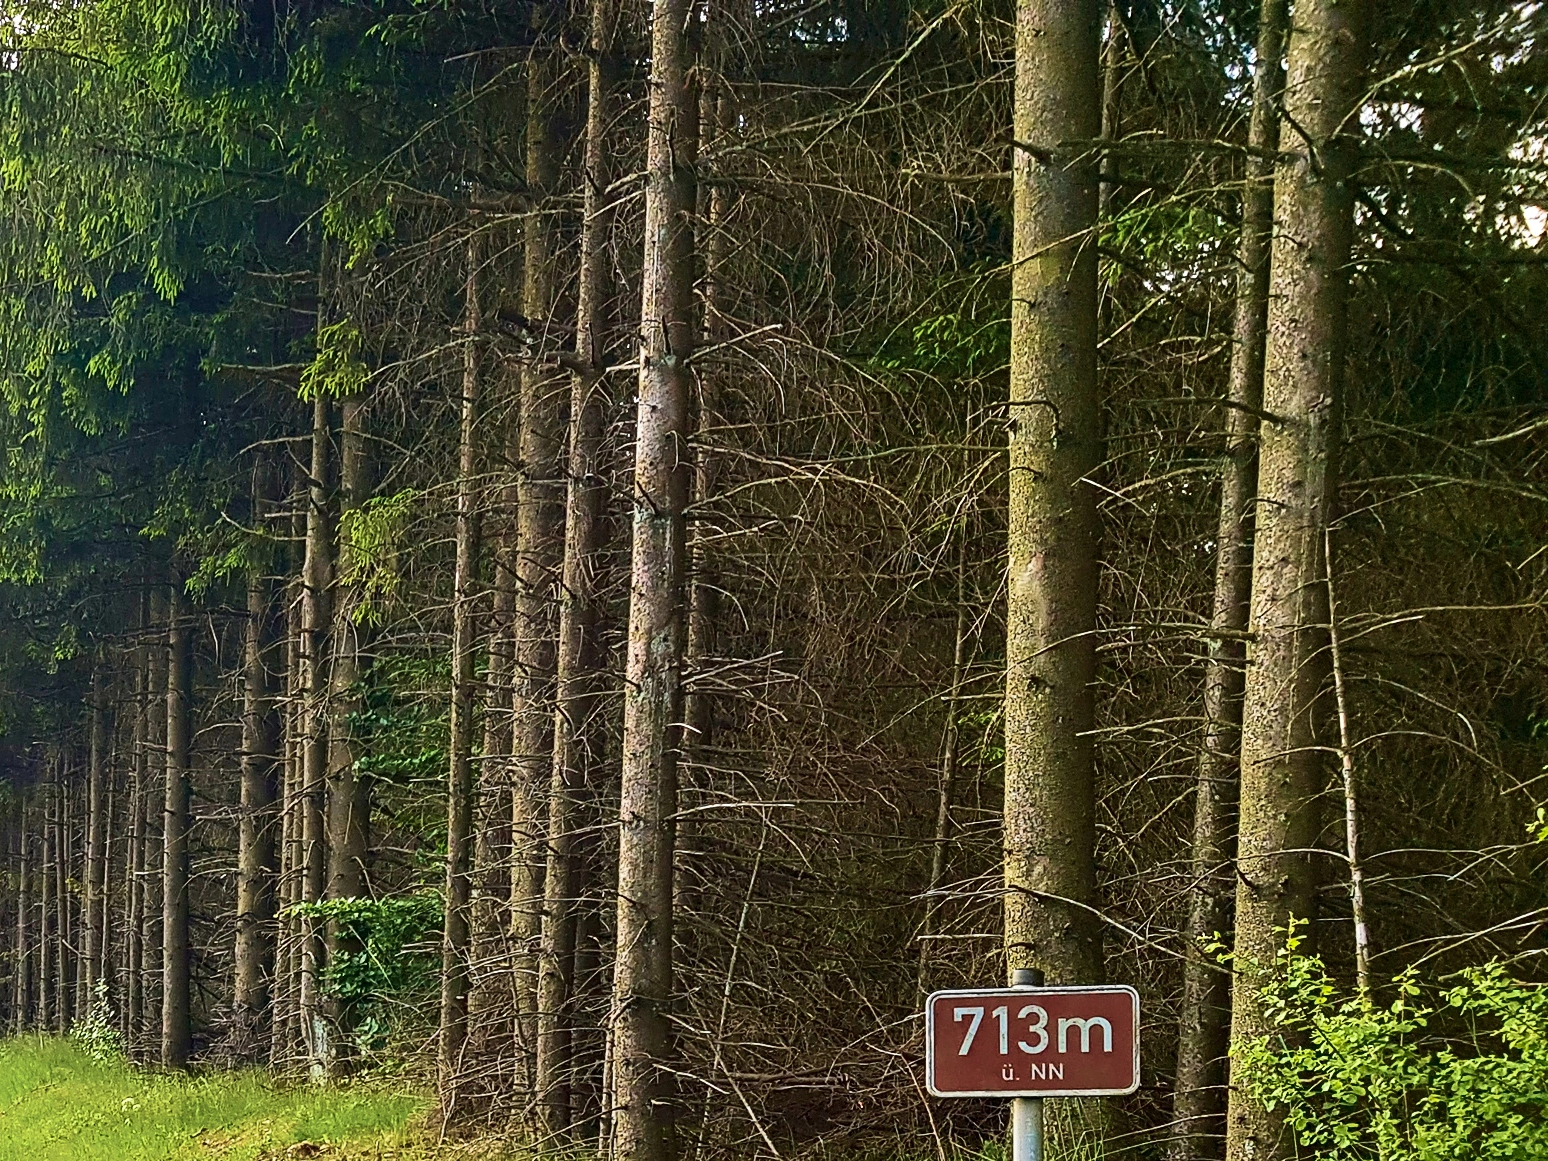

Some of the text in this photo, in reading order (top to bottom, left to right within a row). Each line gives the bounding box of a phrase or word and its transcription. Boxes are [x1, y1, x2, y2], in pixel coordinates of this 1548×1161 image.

[953, 1004, 1113, 1056] 713m
[1002, 1063, 1065, 1081] ü. NN
